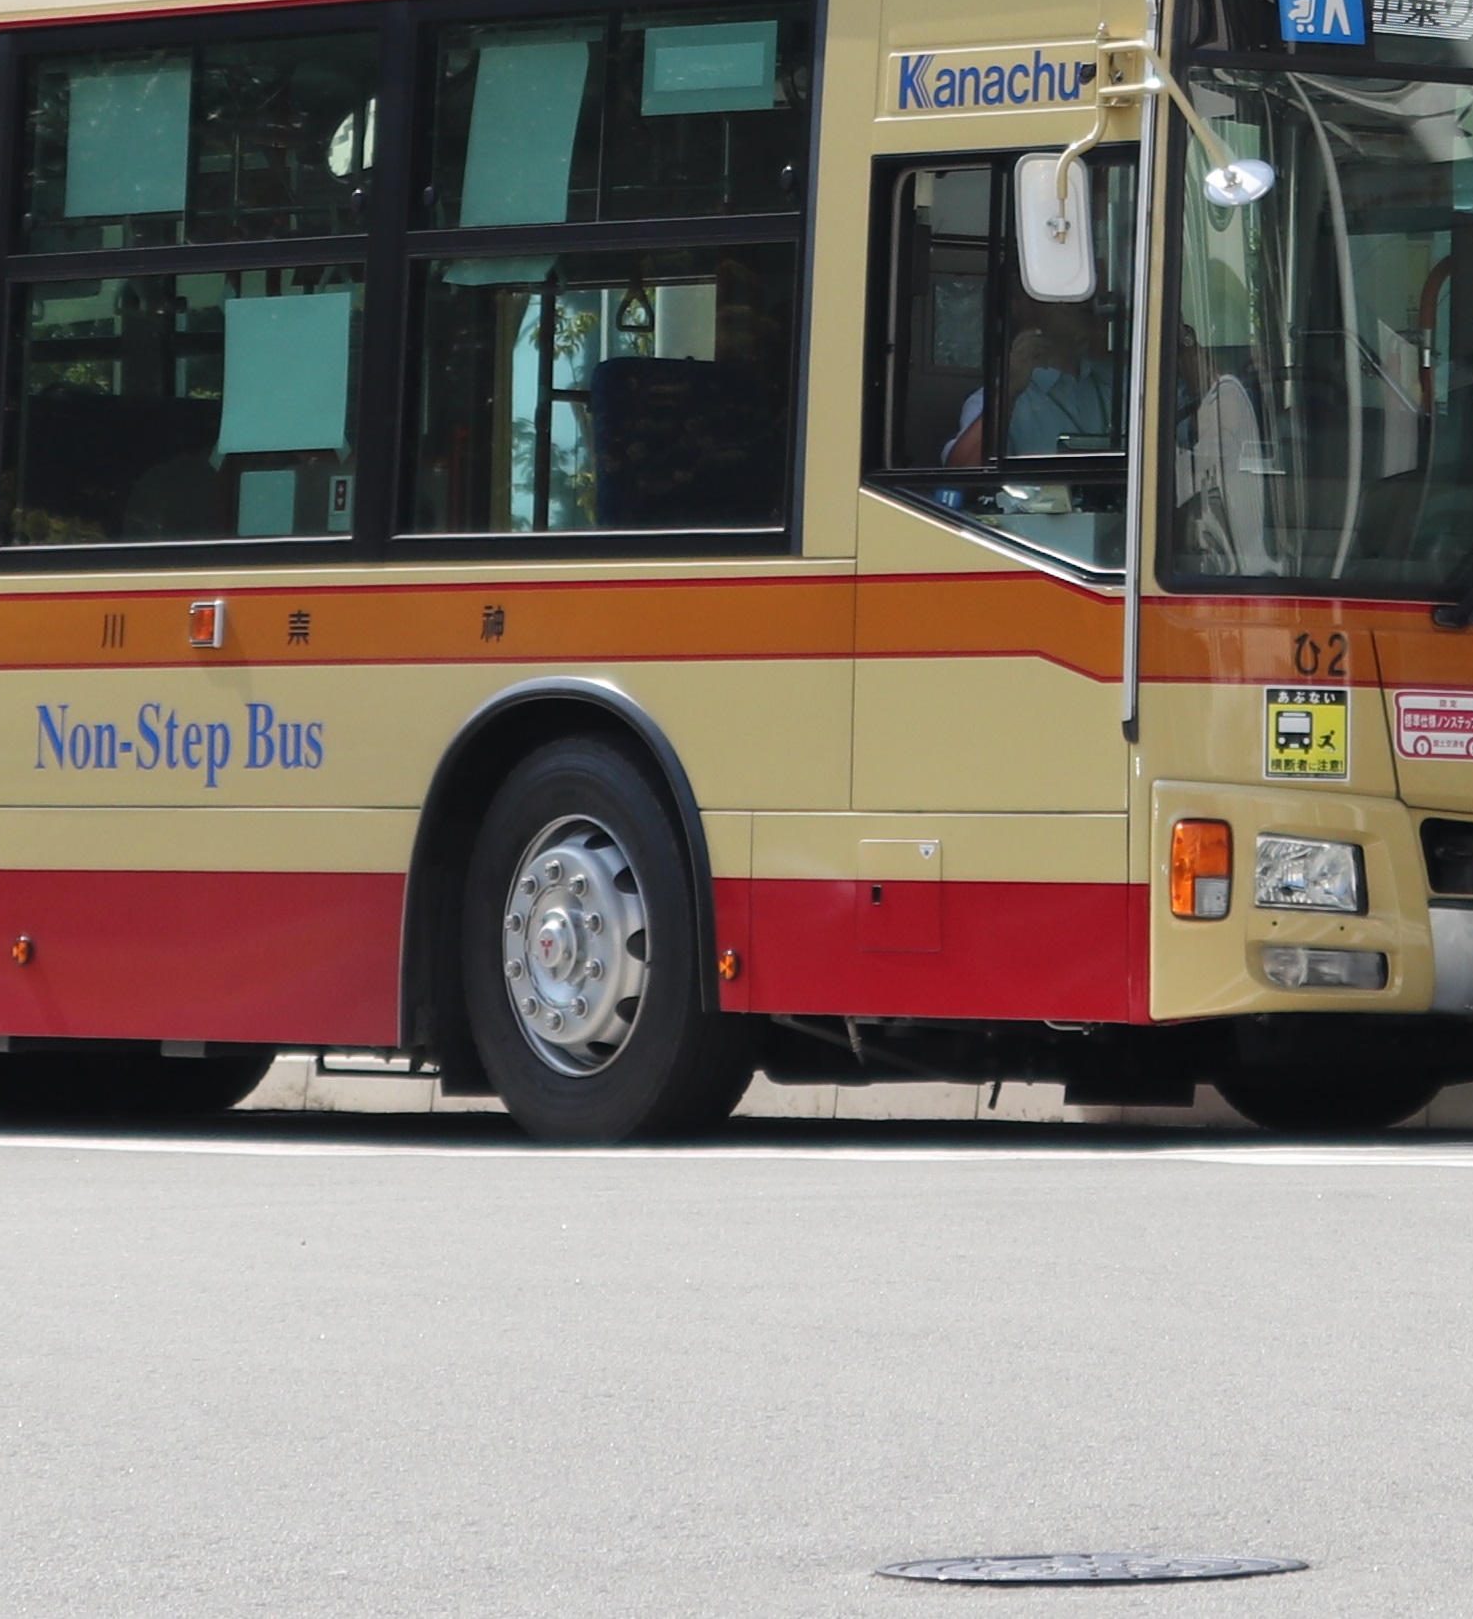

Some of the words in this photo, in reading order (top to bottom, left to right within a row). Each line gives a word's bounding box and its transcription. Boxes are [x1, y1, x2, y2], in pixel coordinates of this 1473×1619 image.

[898, 50, 1082, 110] Kanachu
[1277, 690, 1337, 705] あぶない
[33, 702, 230, 788] Non-Step
[243, 701, 325, 770] Bus
